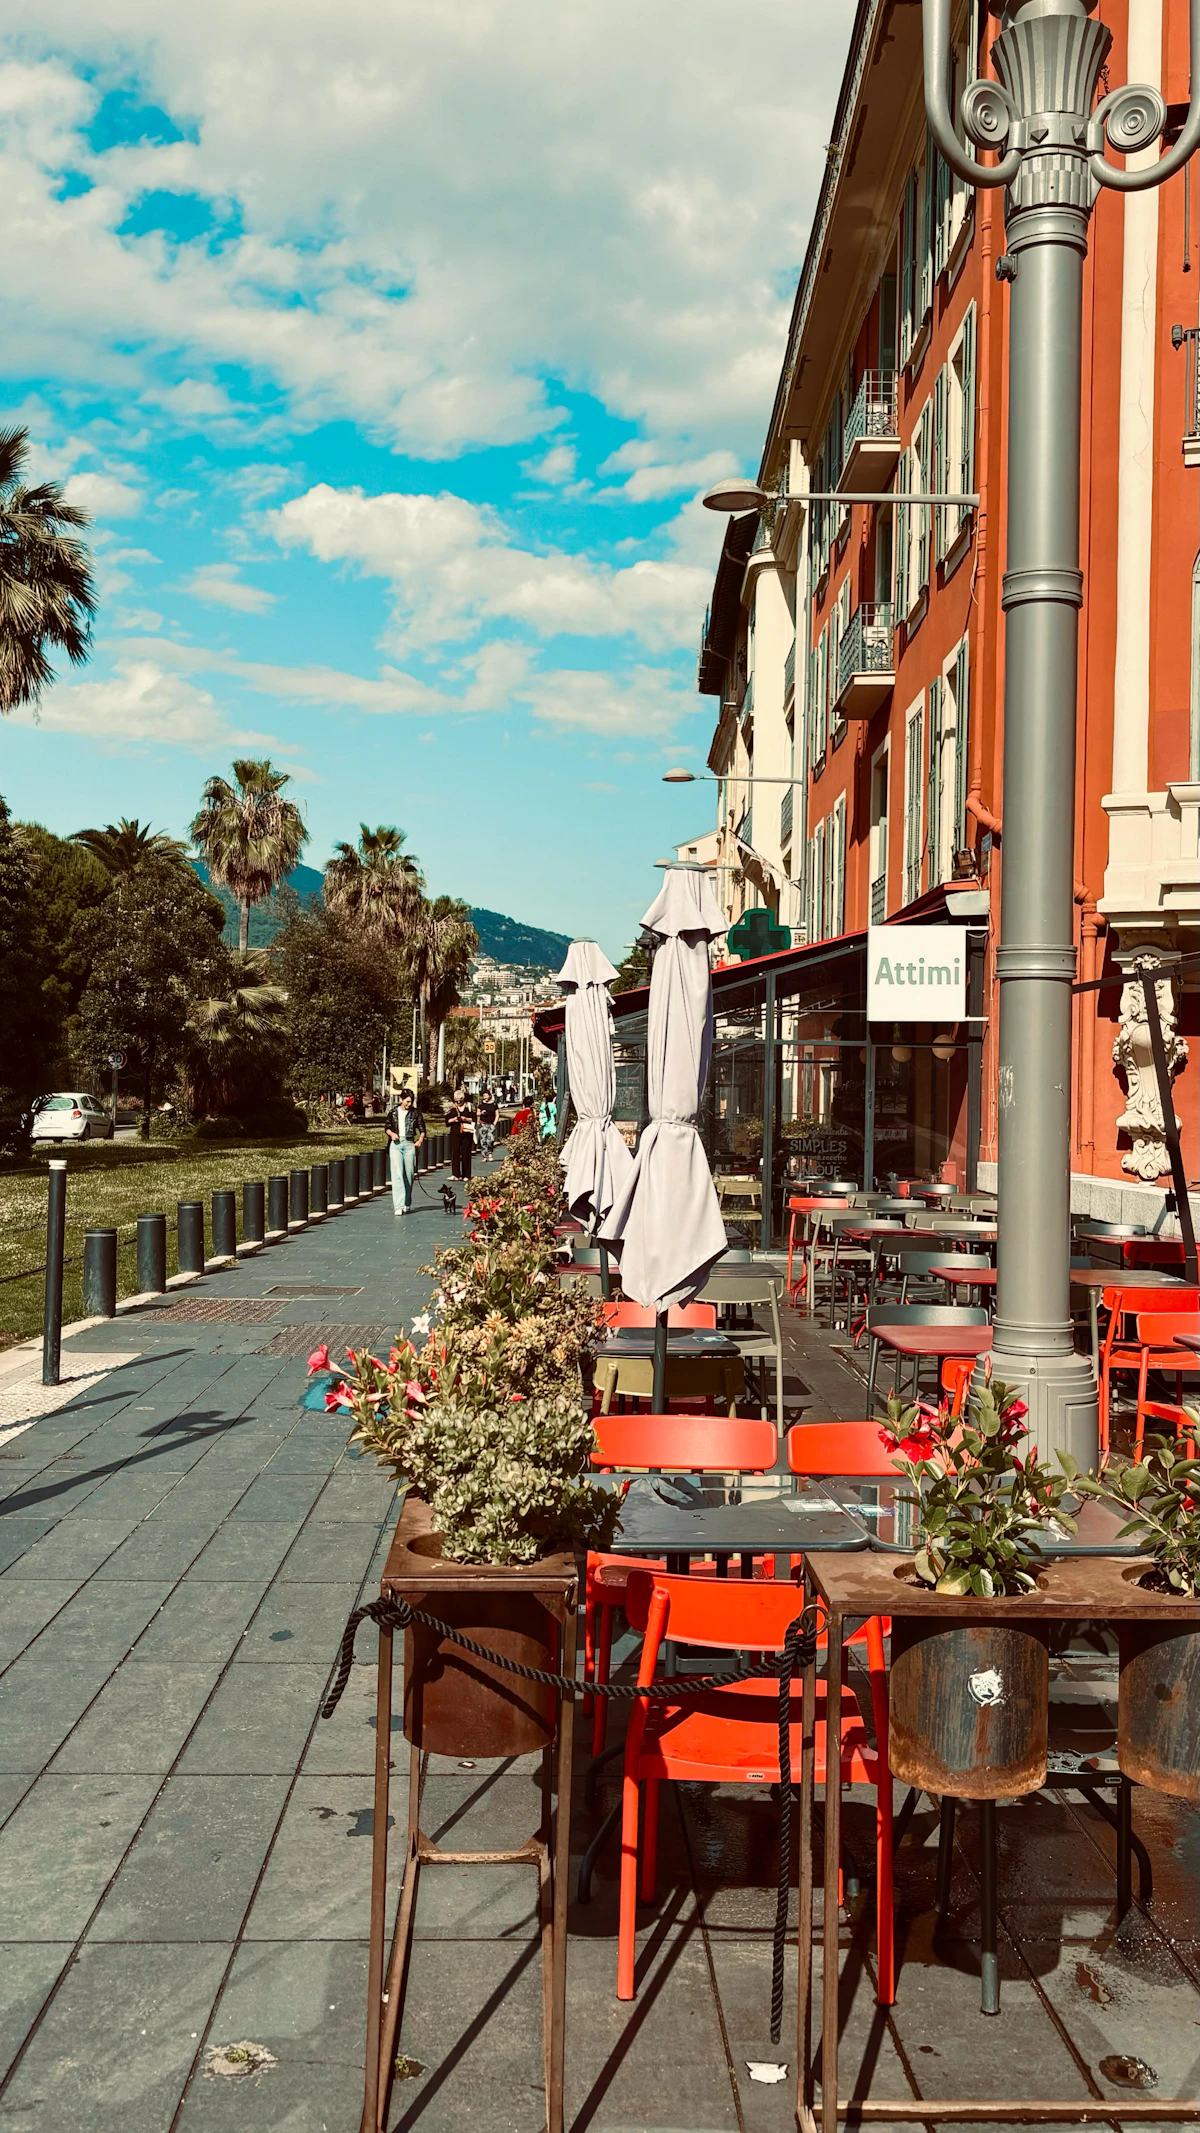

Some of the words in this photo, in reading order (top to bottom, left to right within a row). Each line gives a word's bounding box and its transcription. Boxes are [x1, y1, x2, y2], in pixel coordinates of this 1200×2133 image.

[874, 957, 961, 985] Attimi
[109, 1054, 122, 1064] 30
[789, 1139, 848, 1155] SIMPLES
